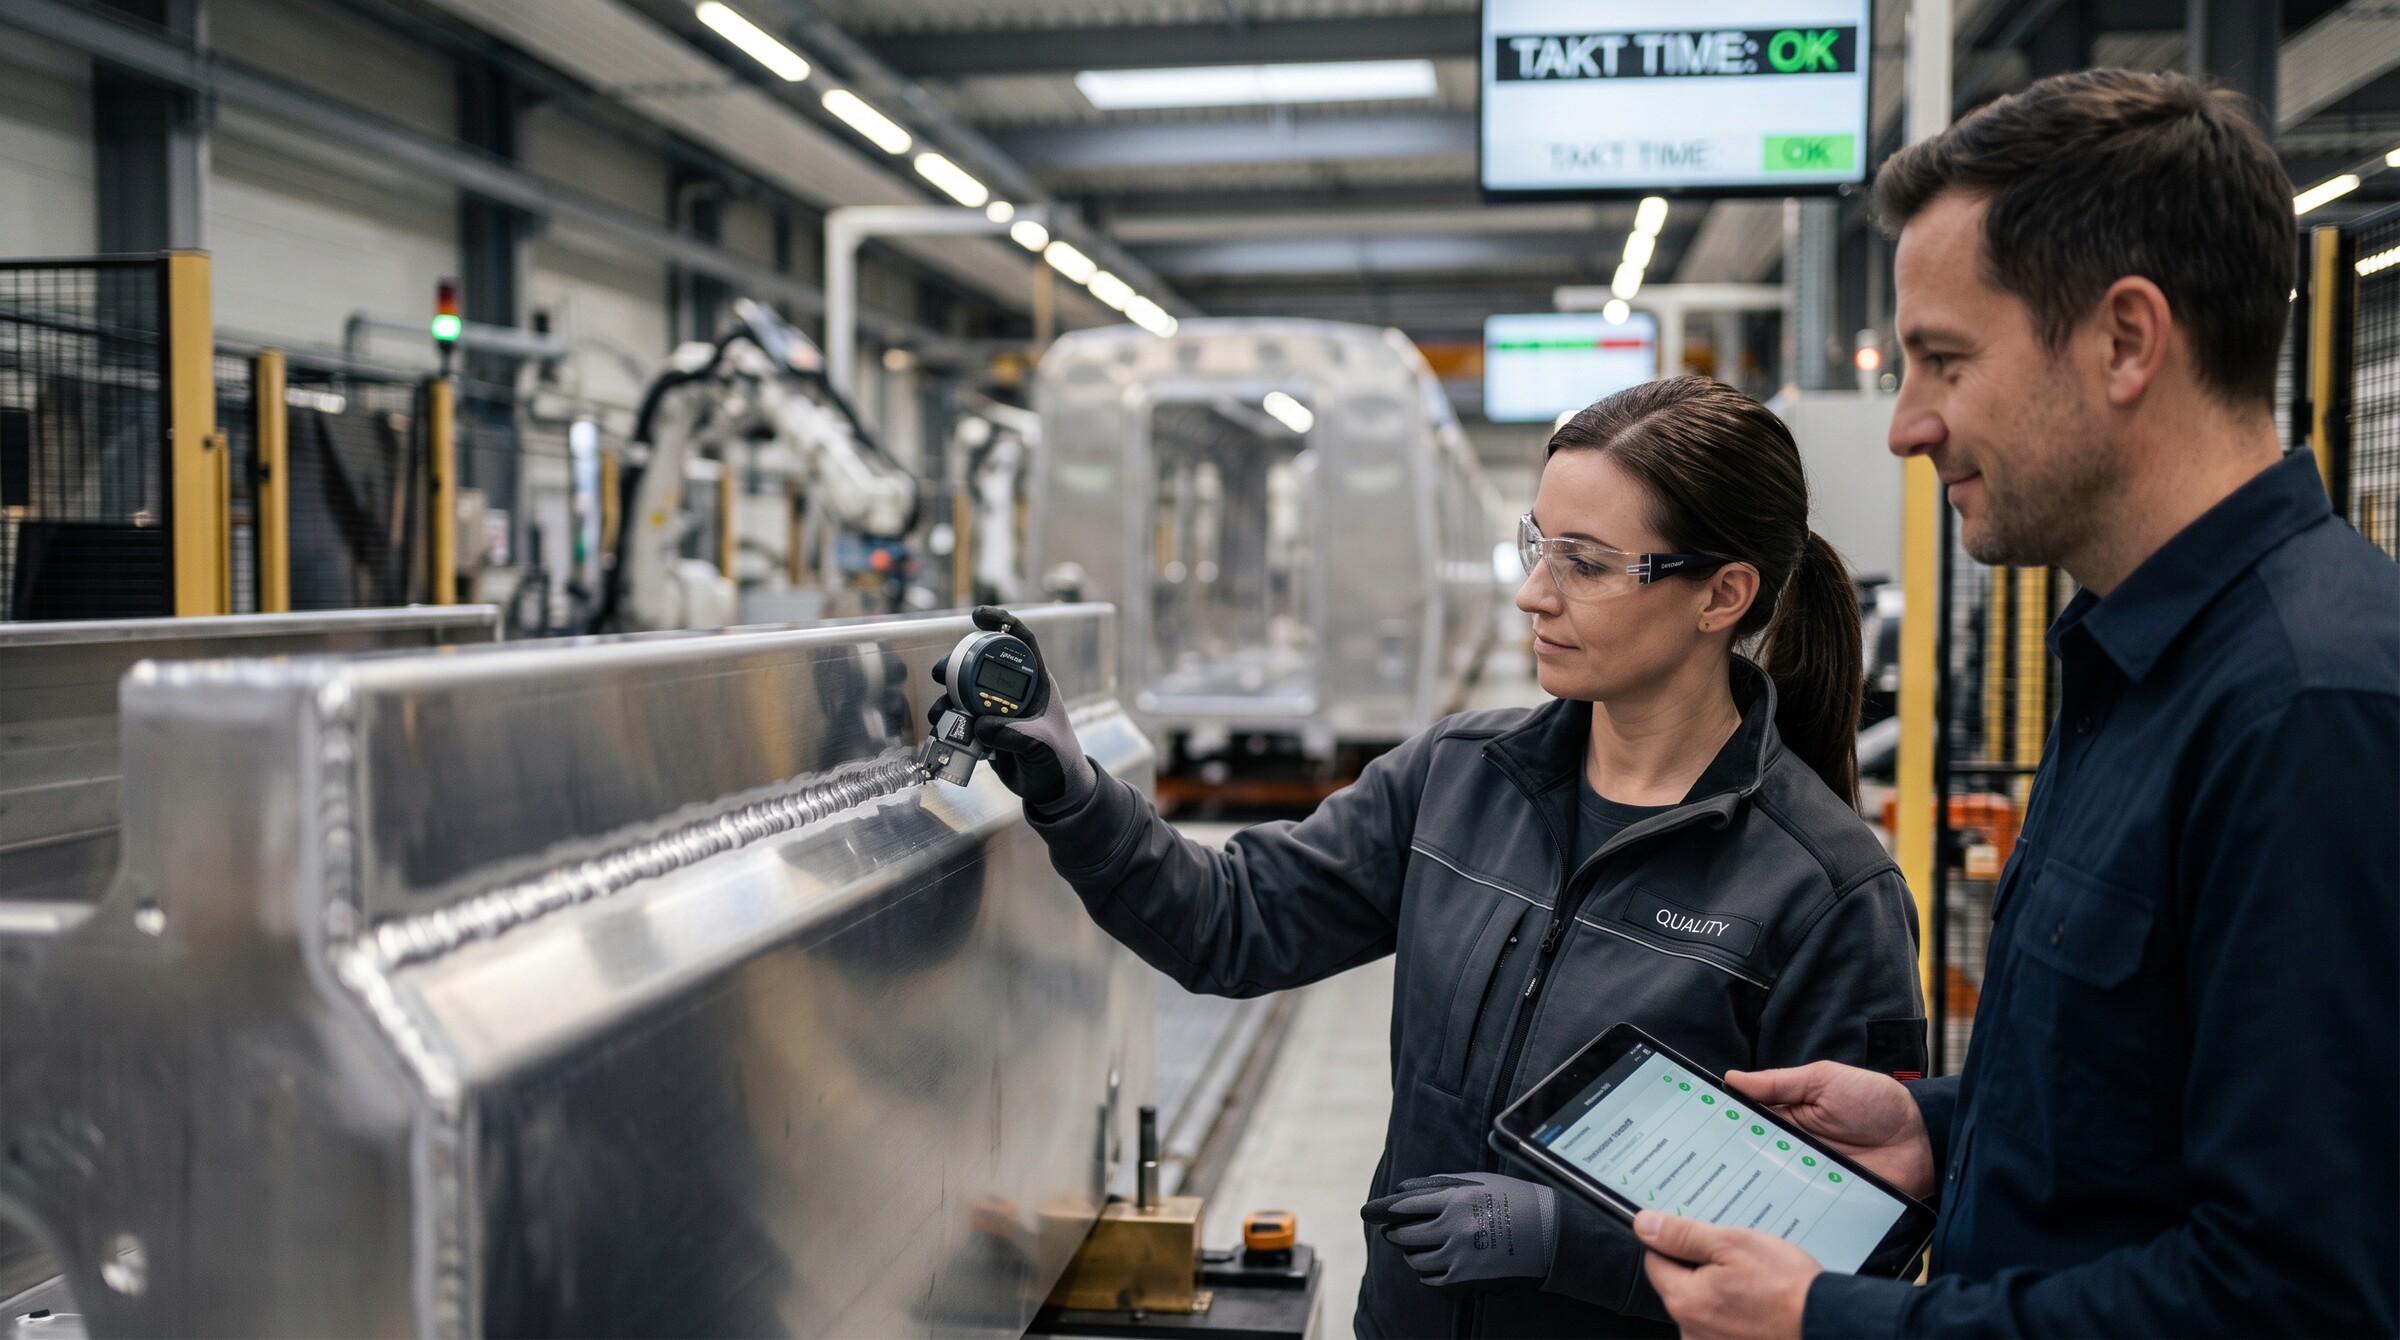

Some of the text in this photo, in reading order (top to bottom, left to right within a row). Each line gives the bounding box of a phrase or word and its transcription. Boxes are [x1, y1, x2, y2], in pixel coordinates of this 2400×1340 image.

[1510, 29, 1841, 79] TAKT TIME: OK
[1782, 136, 1832, 168] OK
[1656, 909, 1730, 936] QUALITY
